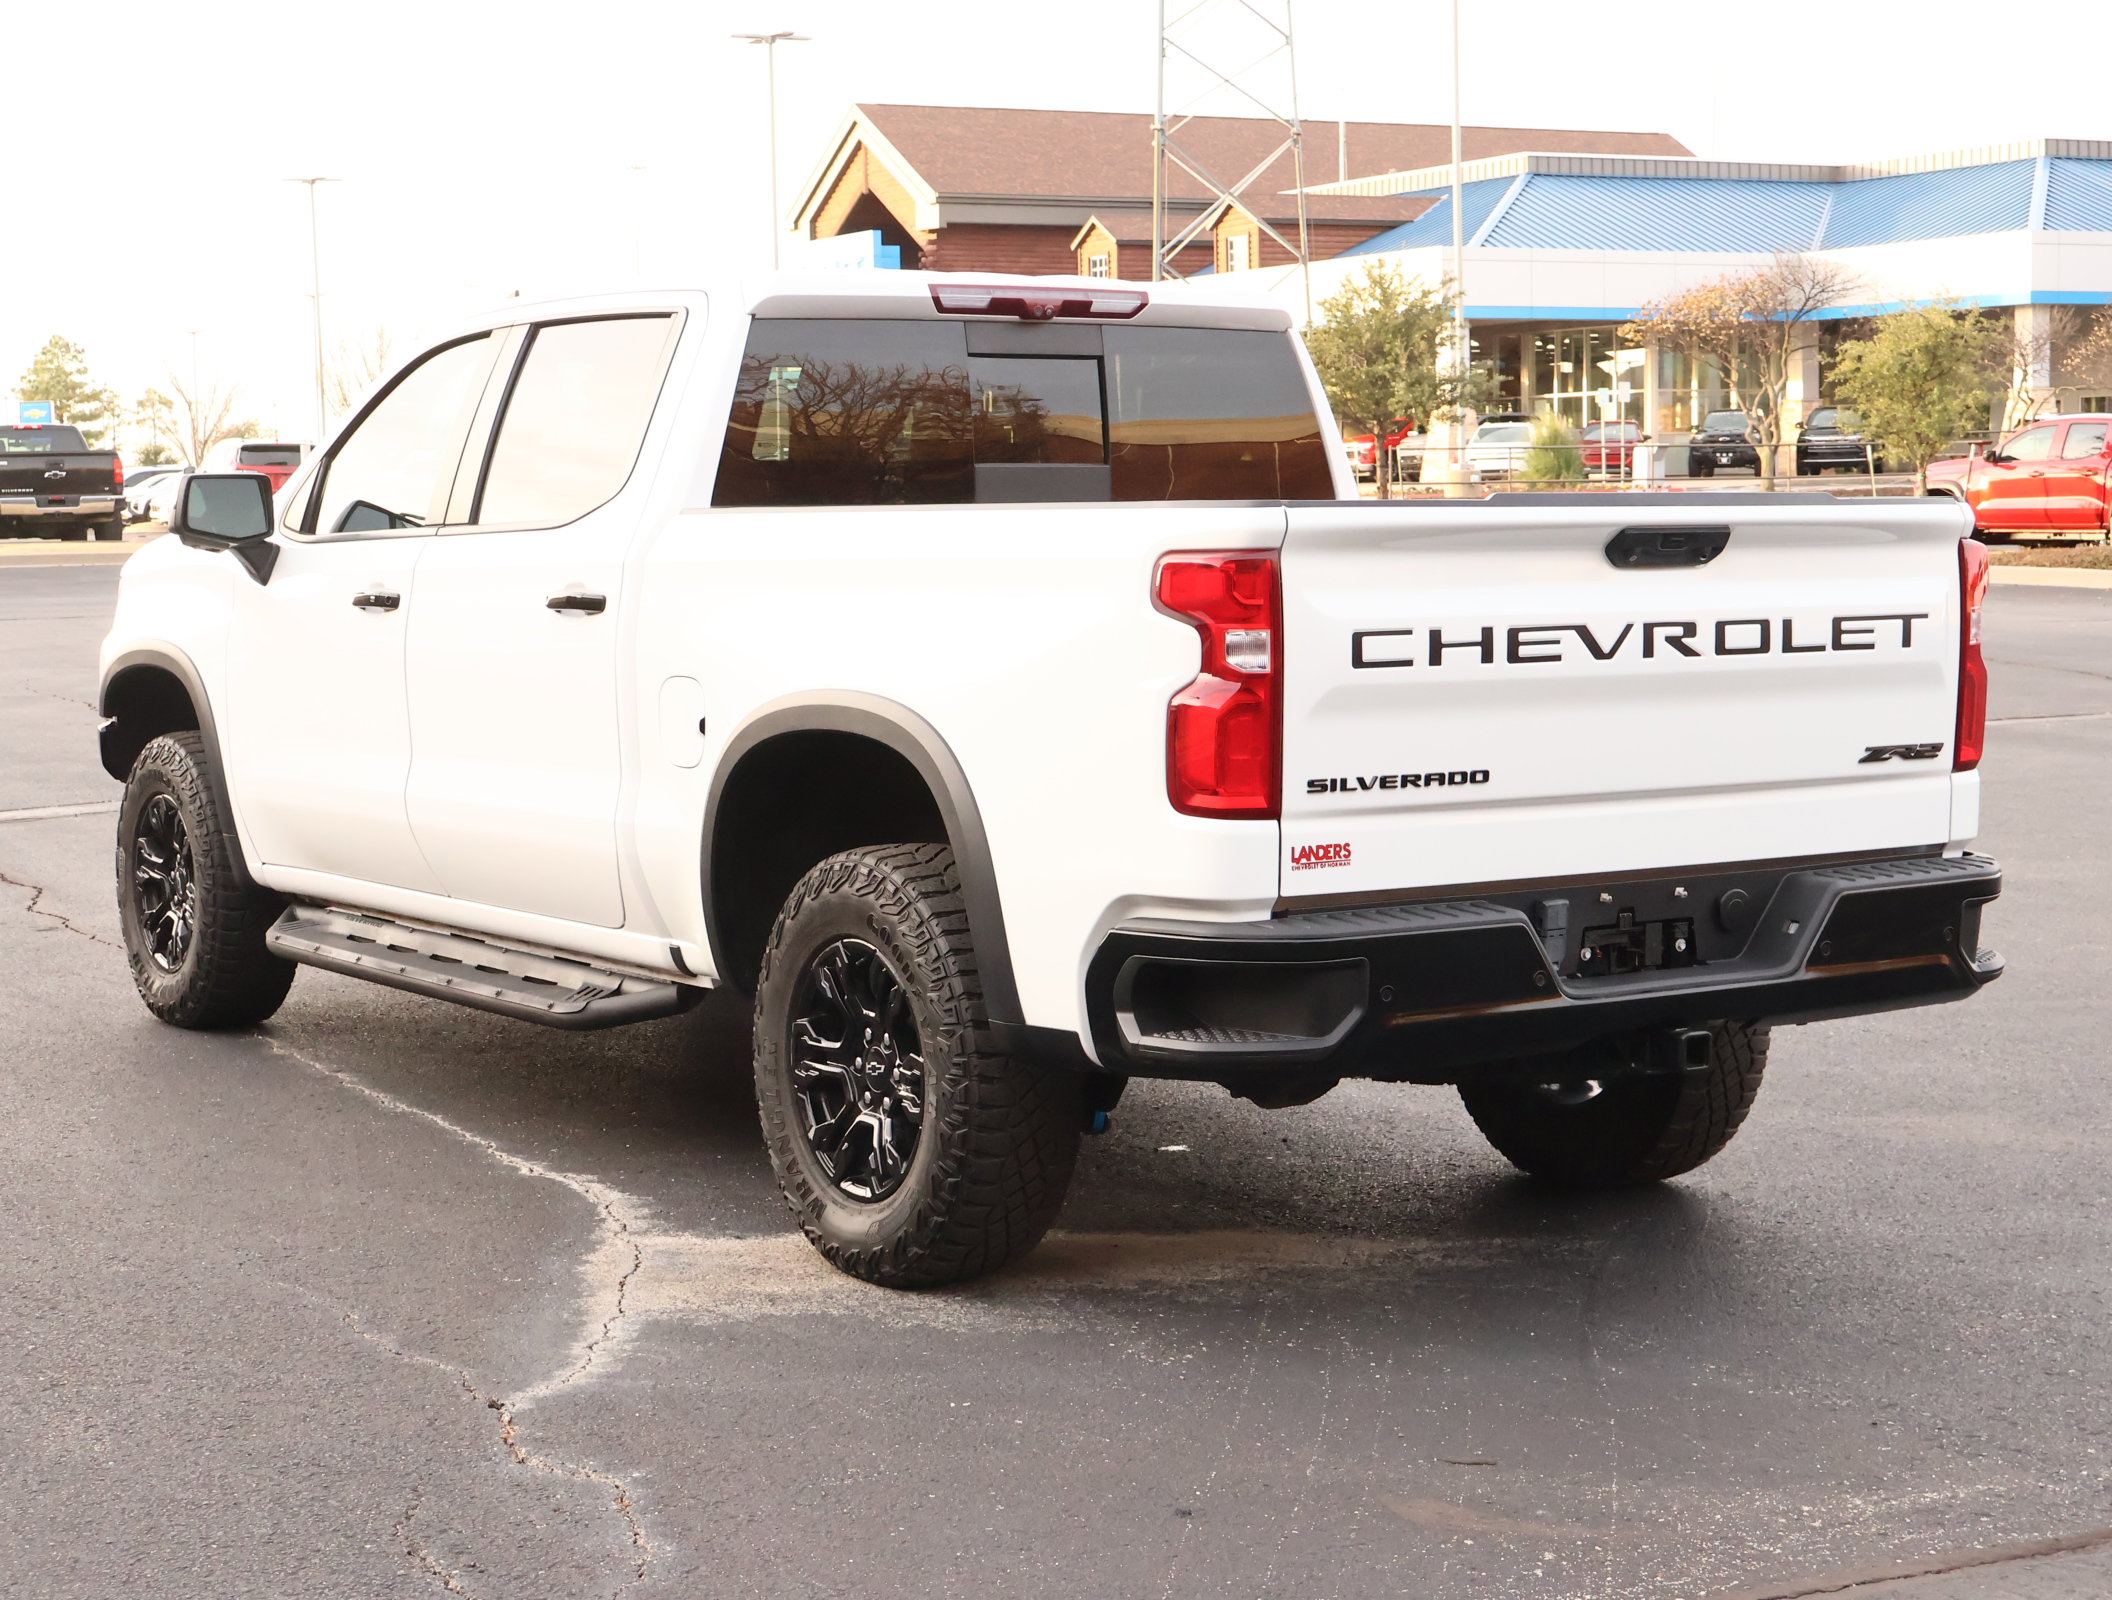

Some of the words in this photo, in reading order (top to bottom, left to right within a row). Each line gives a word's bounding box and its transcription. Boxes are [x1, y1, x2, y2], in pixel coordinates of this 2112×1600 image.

[1352, 613, 1929, 669] CHEVROLET
[1858, 742, 1944, 764] ZR2
[1306, 769, 1490, 794] SILVERADO
[1291, 842, 1351, 865] LANDERS
